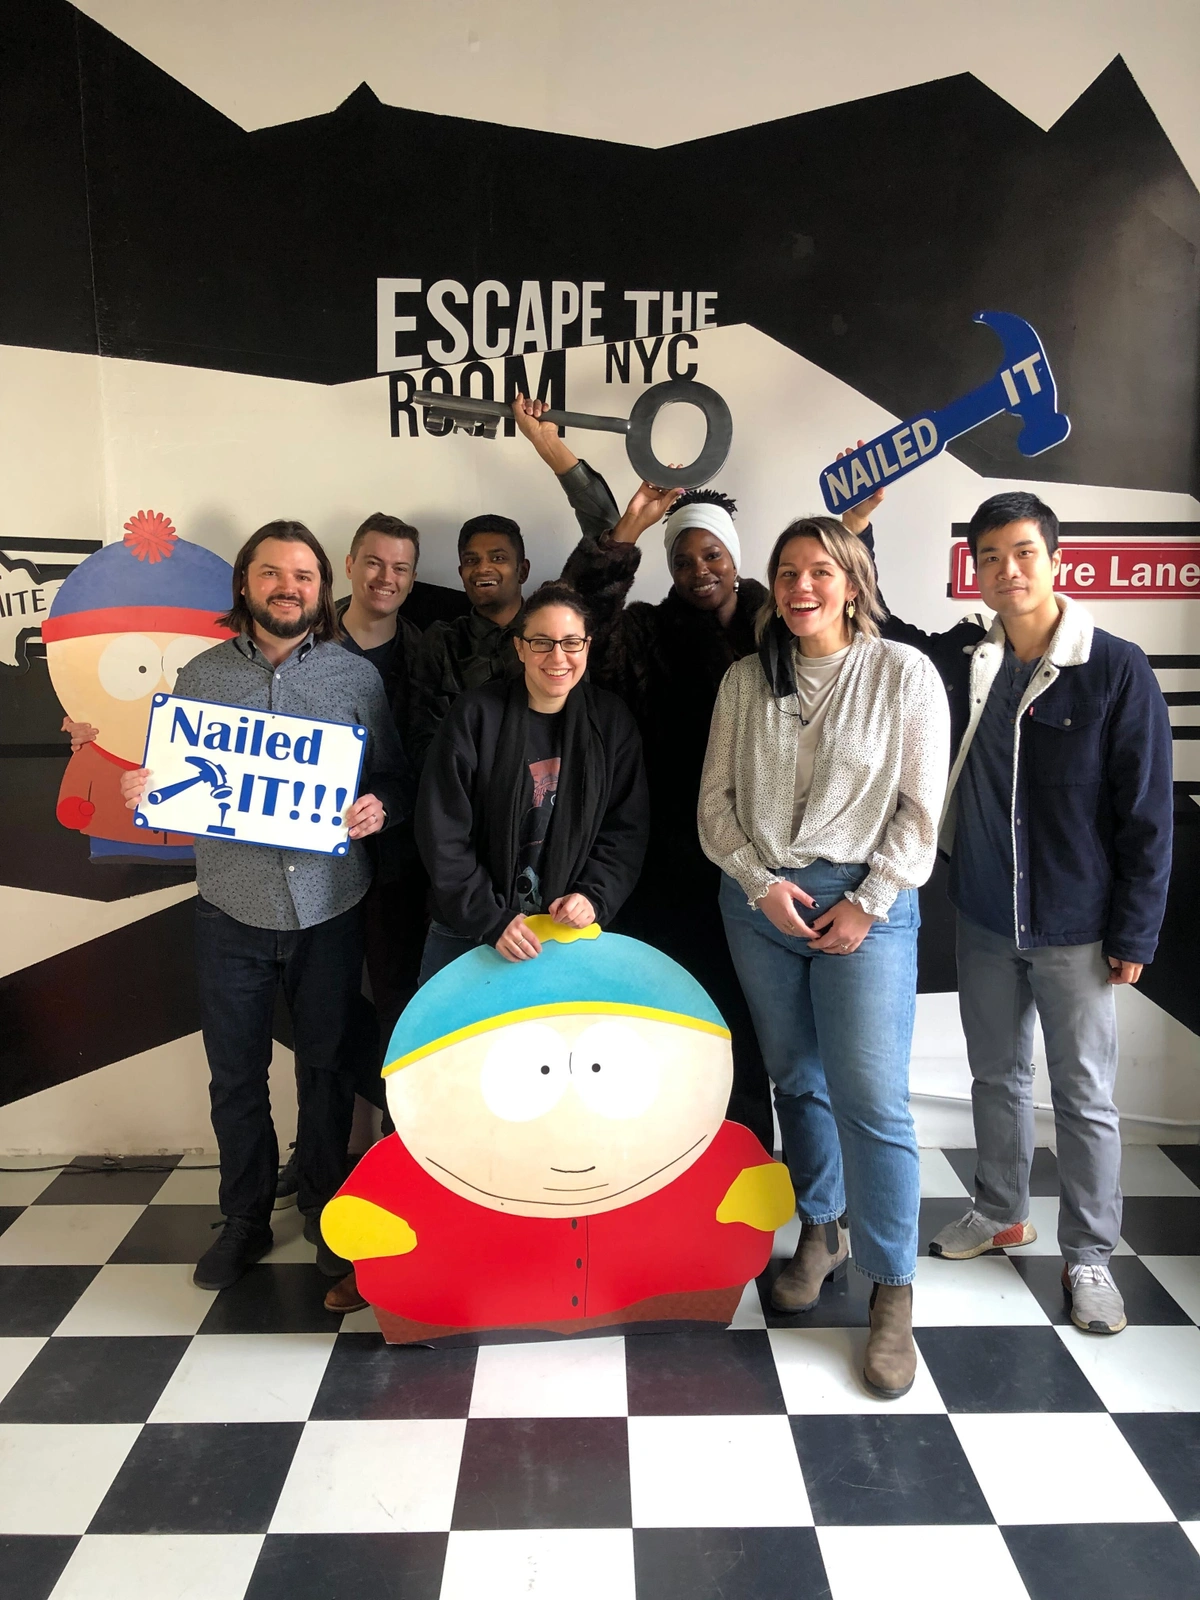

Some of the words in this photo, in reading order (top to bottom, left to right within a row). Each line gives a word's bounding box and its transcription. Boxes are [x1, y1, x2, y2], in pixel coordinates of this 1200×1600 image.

[377, 278, 605, 373] ESCAPE
[624, 290, 719, 339] THE
[606, 334, 698, 384] NYC
[826, 419, 938, 507] NAILED
[1000, 352, 1042, 407] IT
[1110, 555, 1200, 587] Lane
[0, 589, 47, 618] ITE
[170, 706, 323, 766] Nailed
[237, 773, 348, 826] IT!!!
